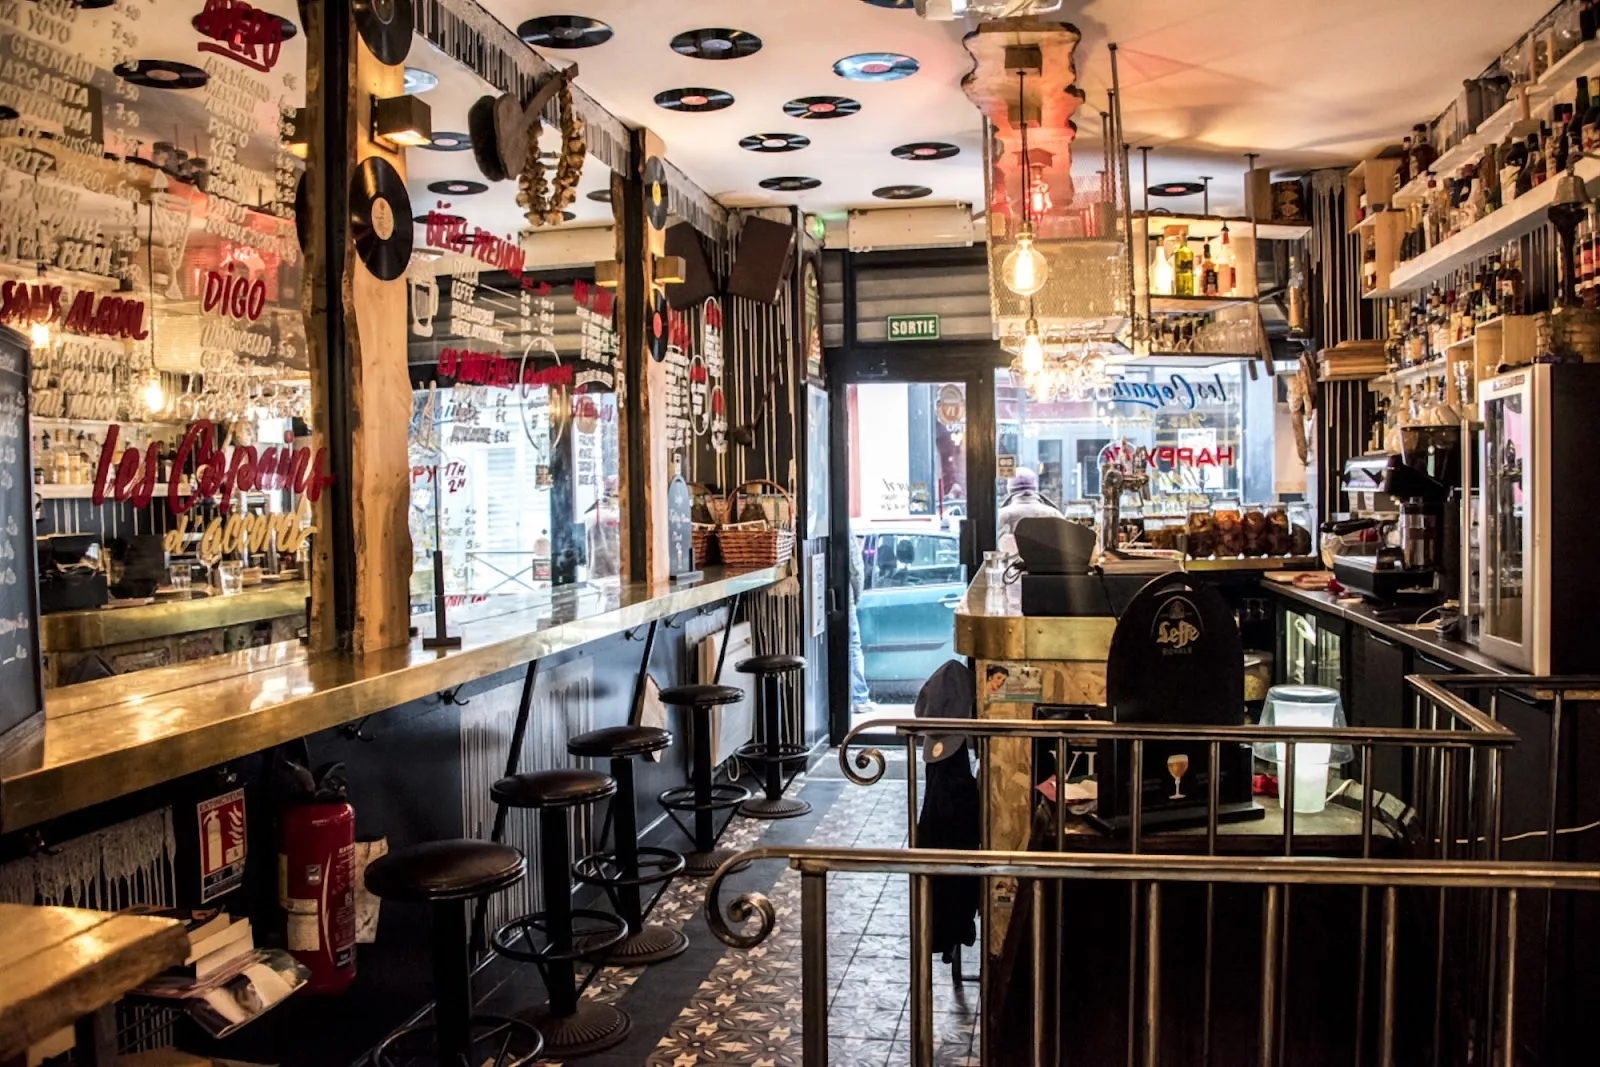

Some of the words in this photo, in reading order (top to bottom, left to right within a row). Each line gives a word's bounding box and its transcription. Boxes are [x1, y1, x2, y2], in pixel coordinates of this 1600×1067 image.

[0, 53, 89, 108] ARGARITA
[207, 117, 249, 148] PORTO
[0, 142, 55, 175] PRITZ
[209, 137, 237, 161] KIR
[451, 280, 476, 304] LEFFE
[891, 320, 936, 336] SORTIE
[1156, 620, 1201, 649] Leffe
